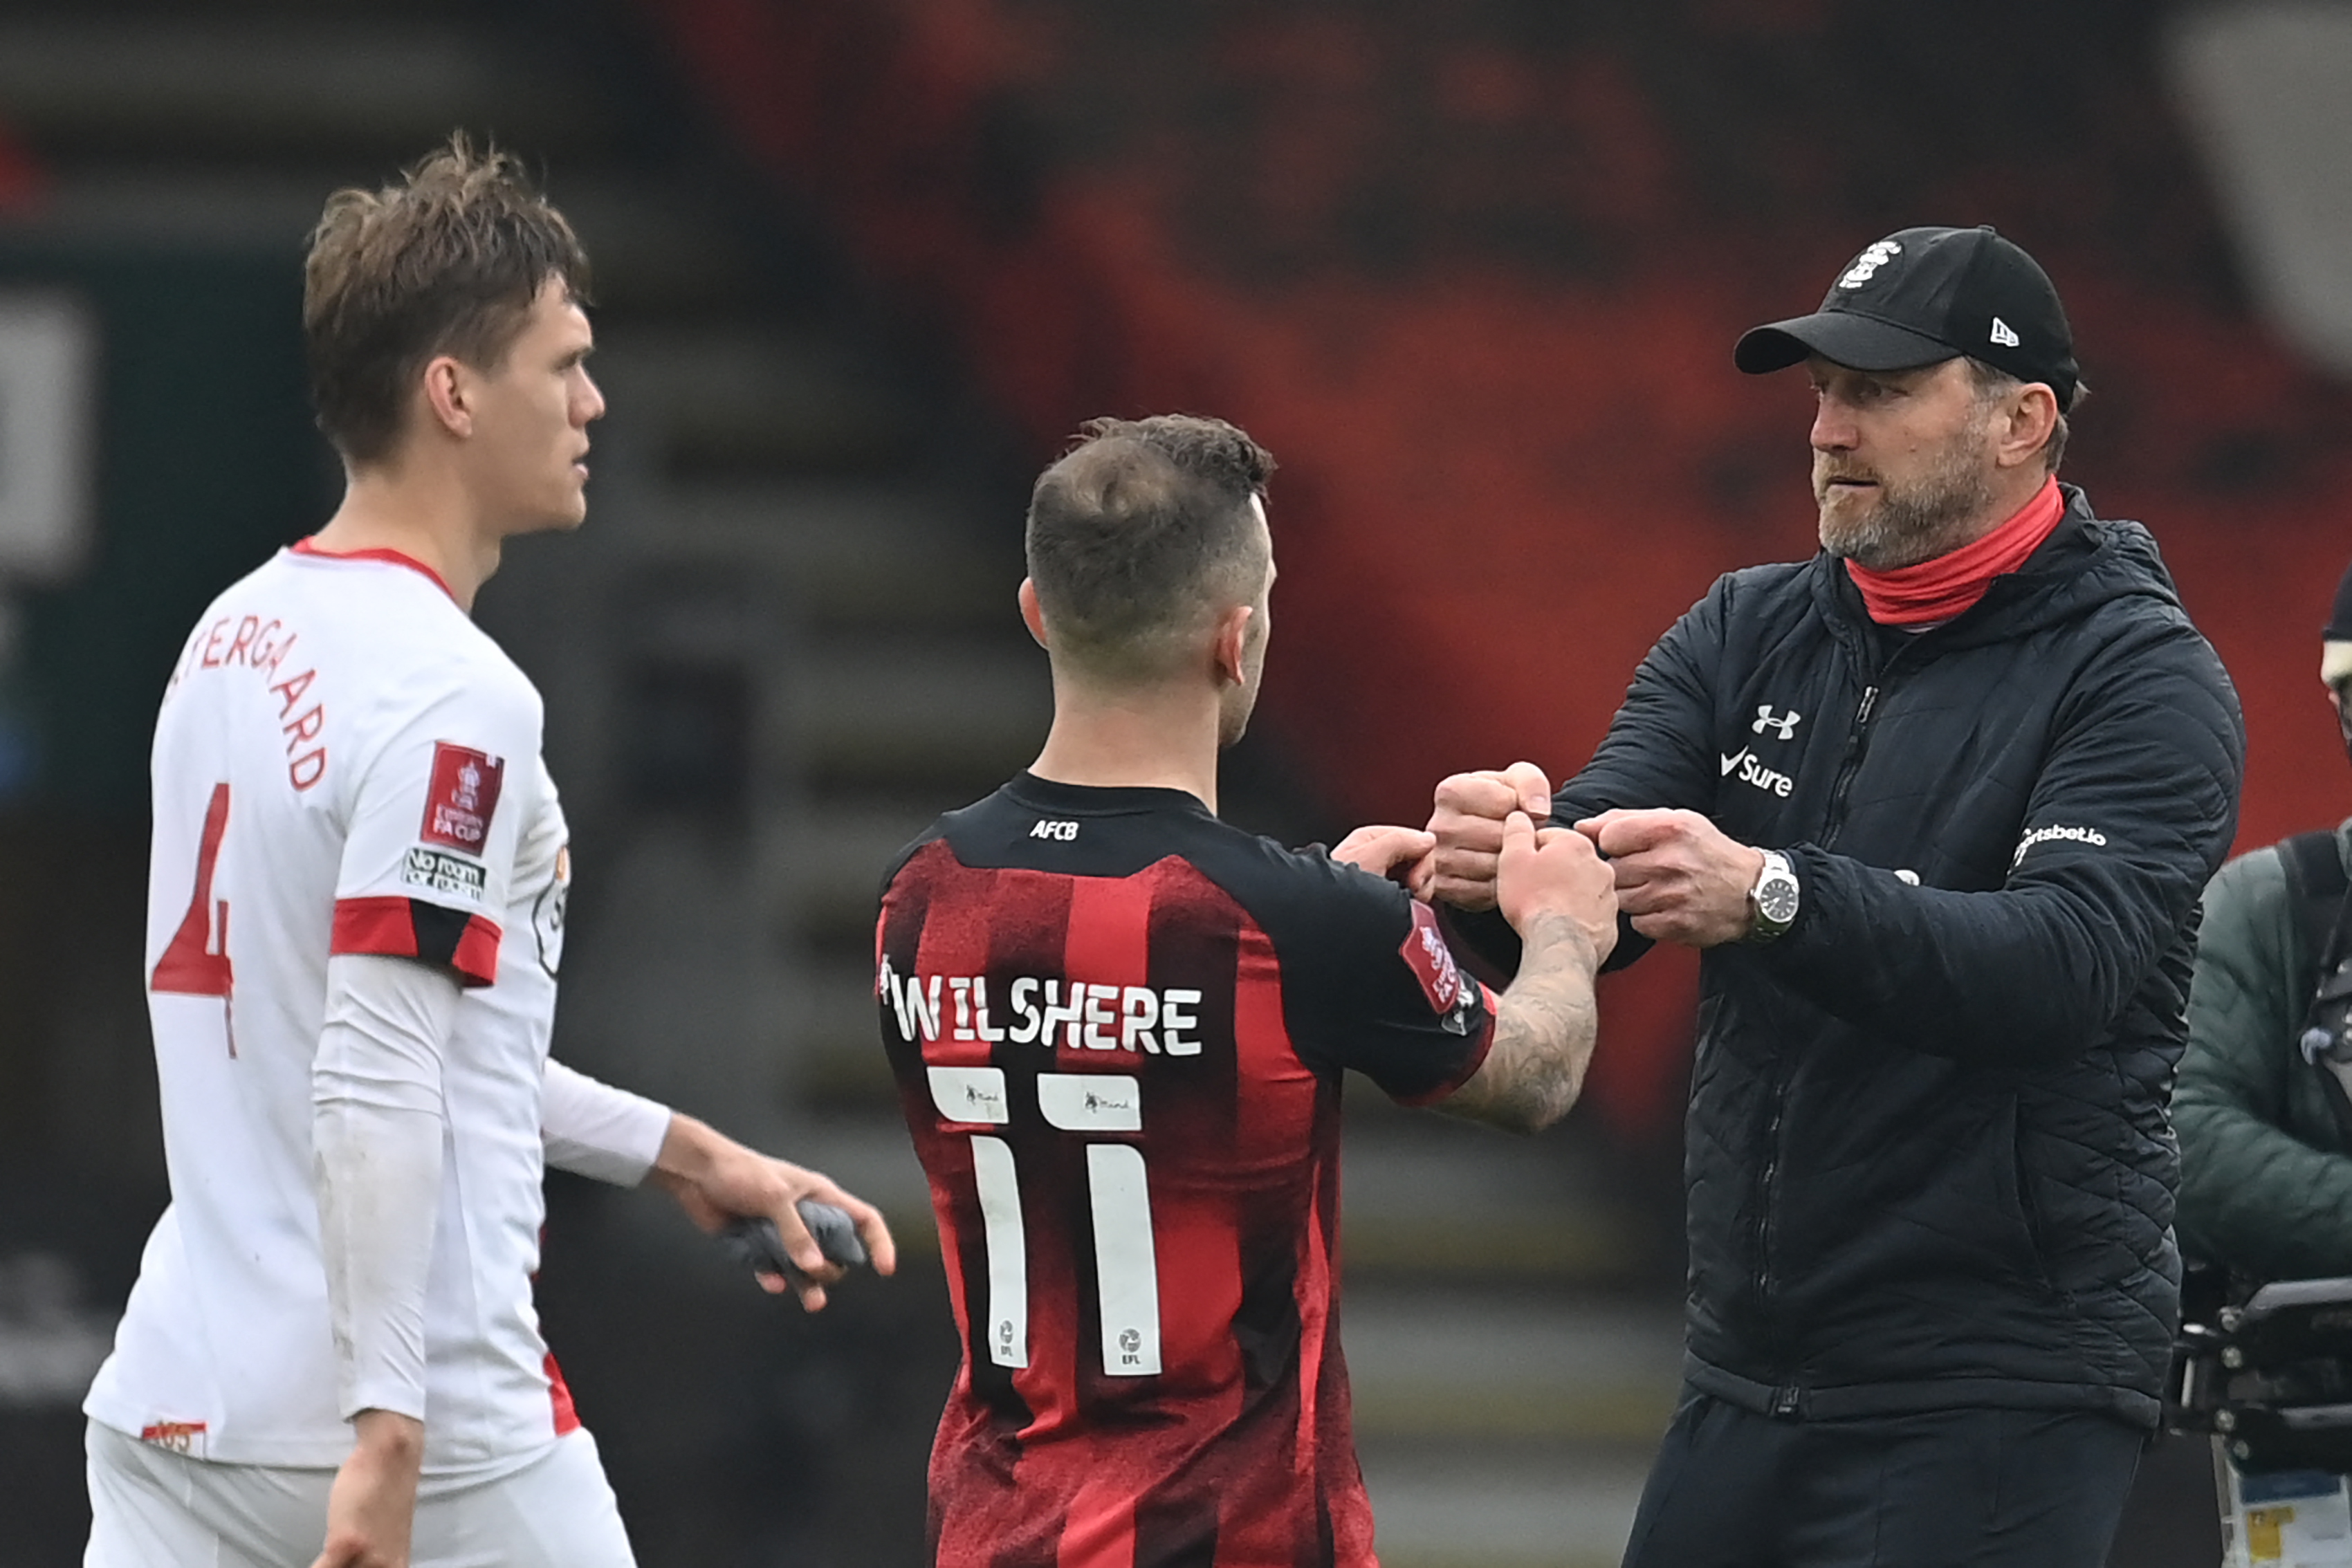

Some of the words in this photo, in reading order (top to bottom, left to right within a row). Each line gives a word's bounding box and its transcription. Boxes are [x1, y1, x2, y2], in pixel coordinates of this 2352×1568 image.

[1738, 754, 1792, 797] Sure
[1029, 820, 1078, 840] AFCB
[150, 782, 237, 1059] 4
[891, 973, 1202, 1056] WILSHERE
[926, 1065, 1162, 1376] 11
[1122, 1354, 1141, 1365] EFL
